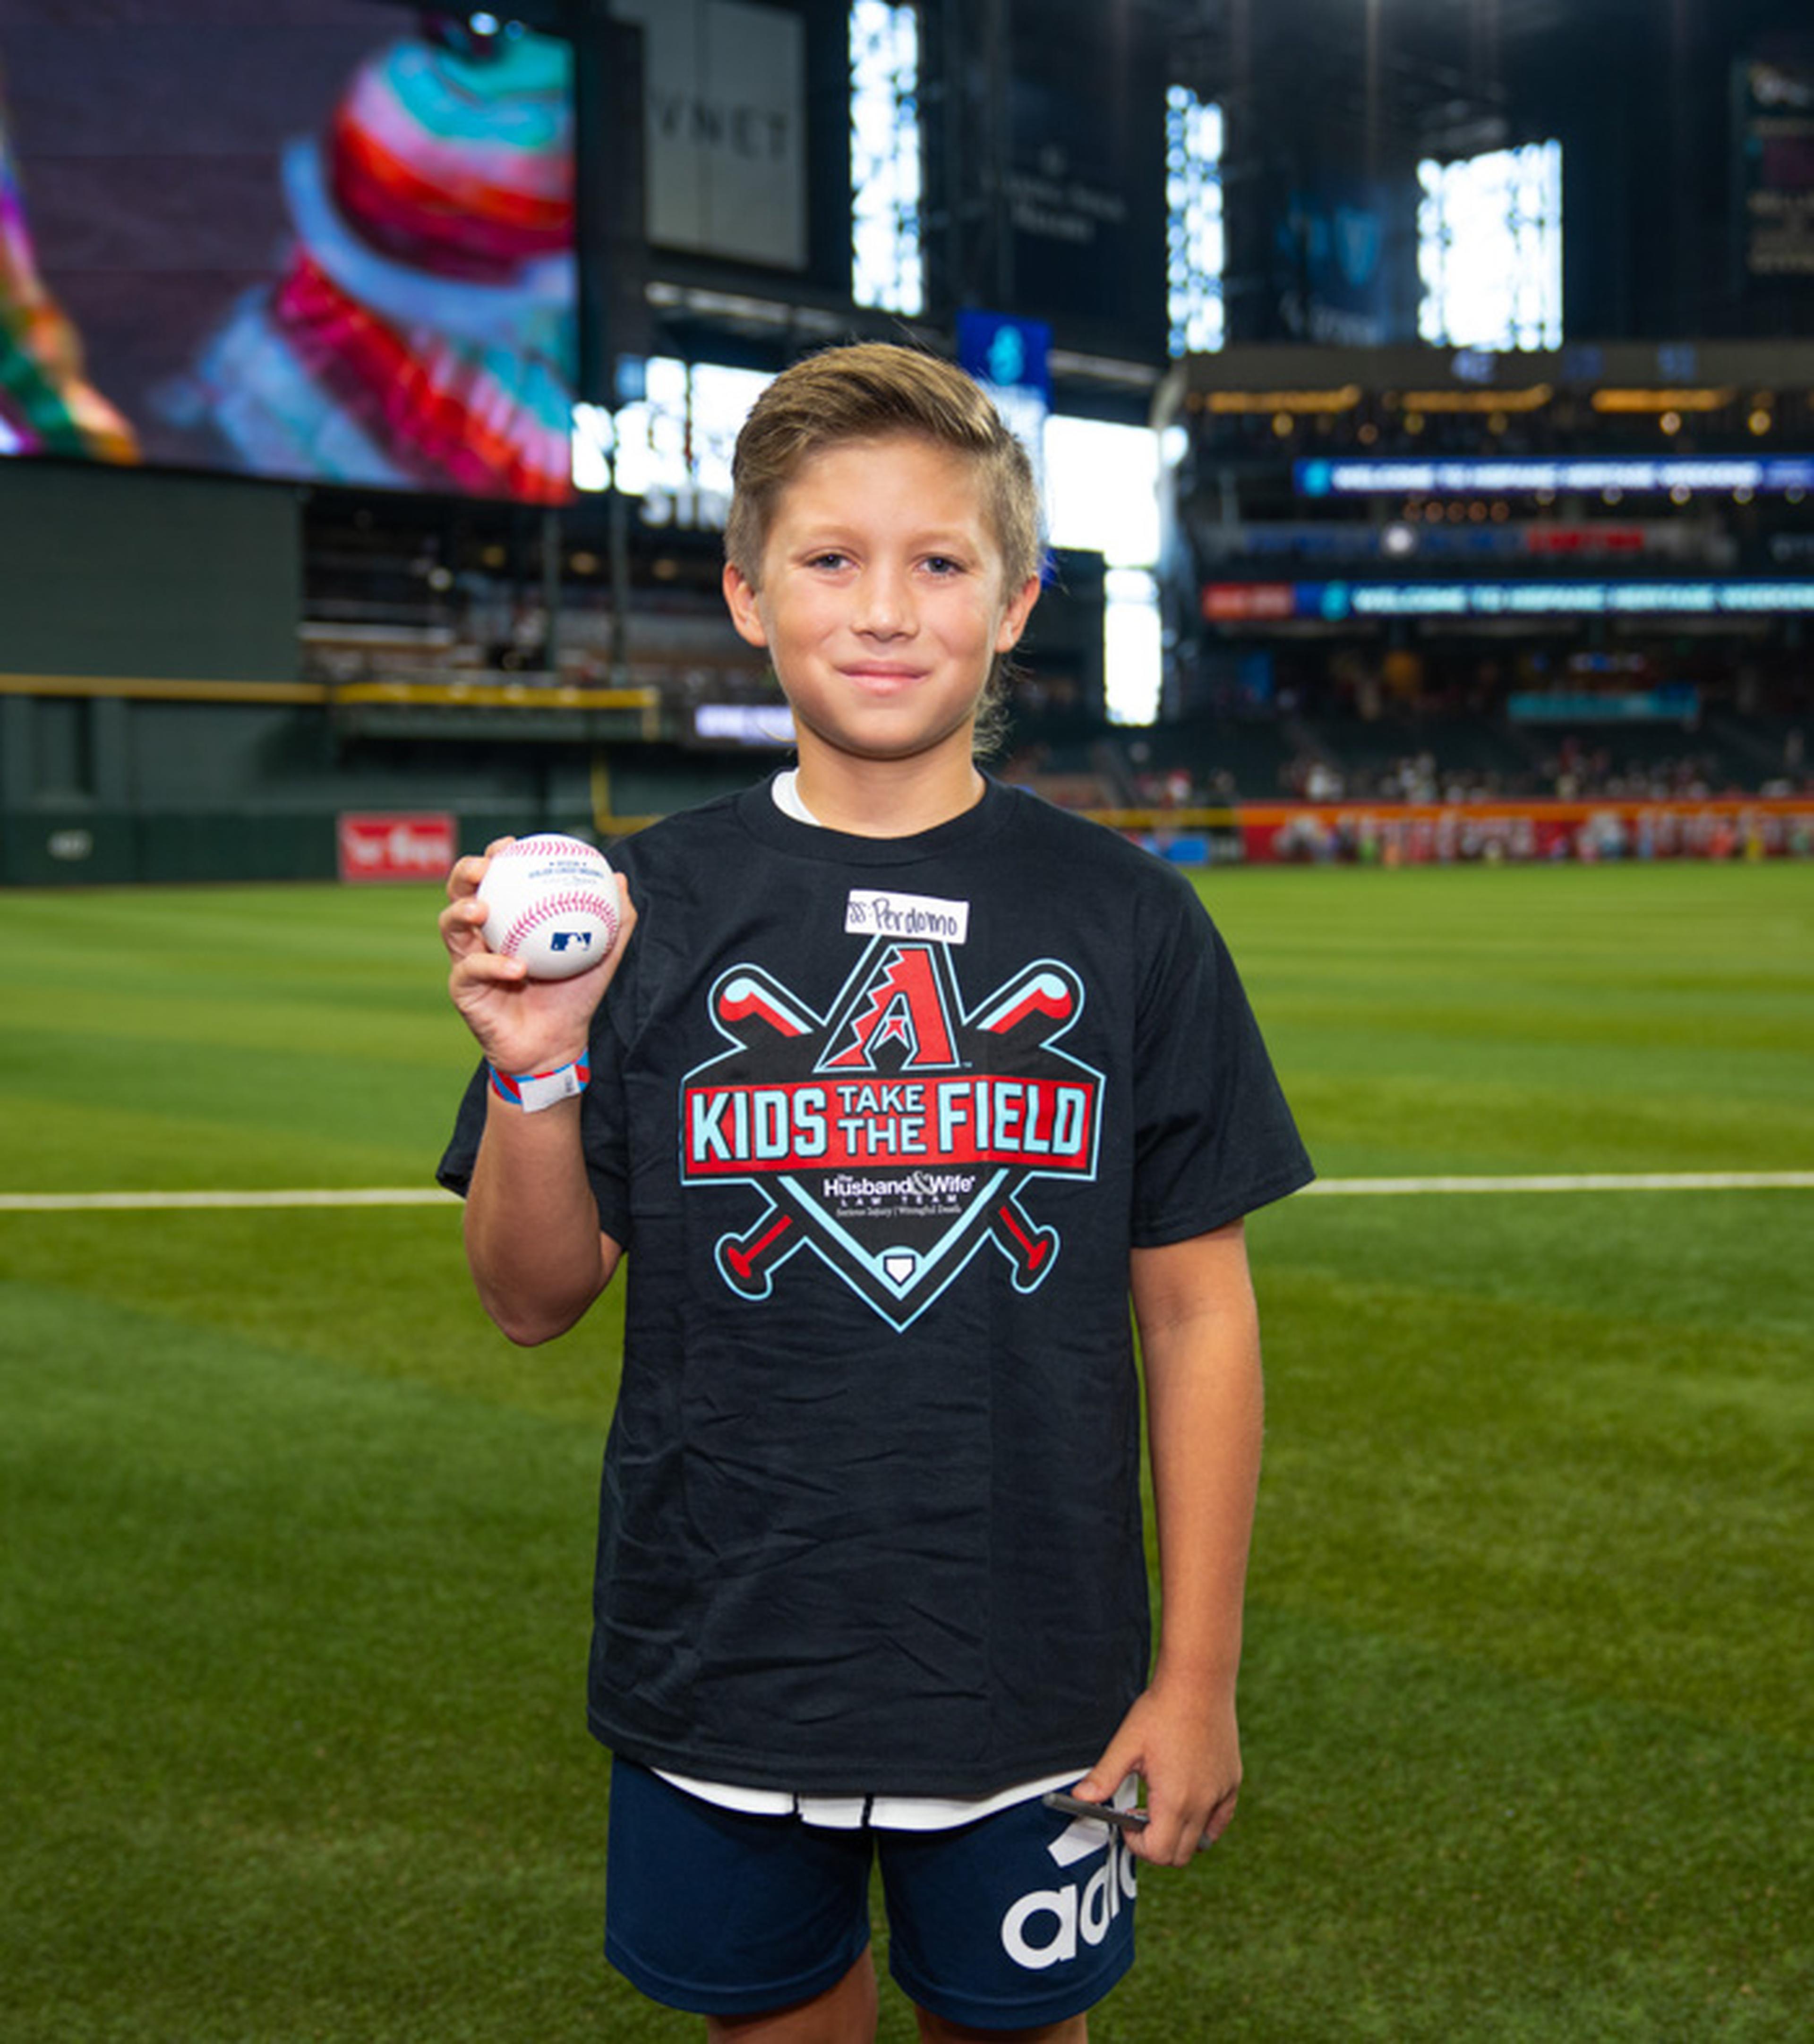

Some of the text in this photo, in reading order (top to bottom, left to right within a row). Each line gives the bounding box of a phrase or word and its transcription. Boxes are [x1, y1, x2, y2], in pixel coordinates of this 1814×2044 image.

[692, 1081, 1086, 1162] KIDS TAKE FIELD
[837, 1116, 927, 1155] THE
[841, 1195, 957, 1207] LAW TEAM
